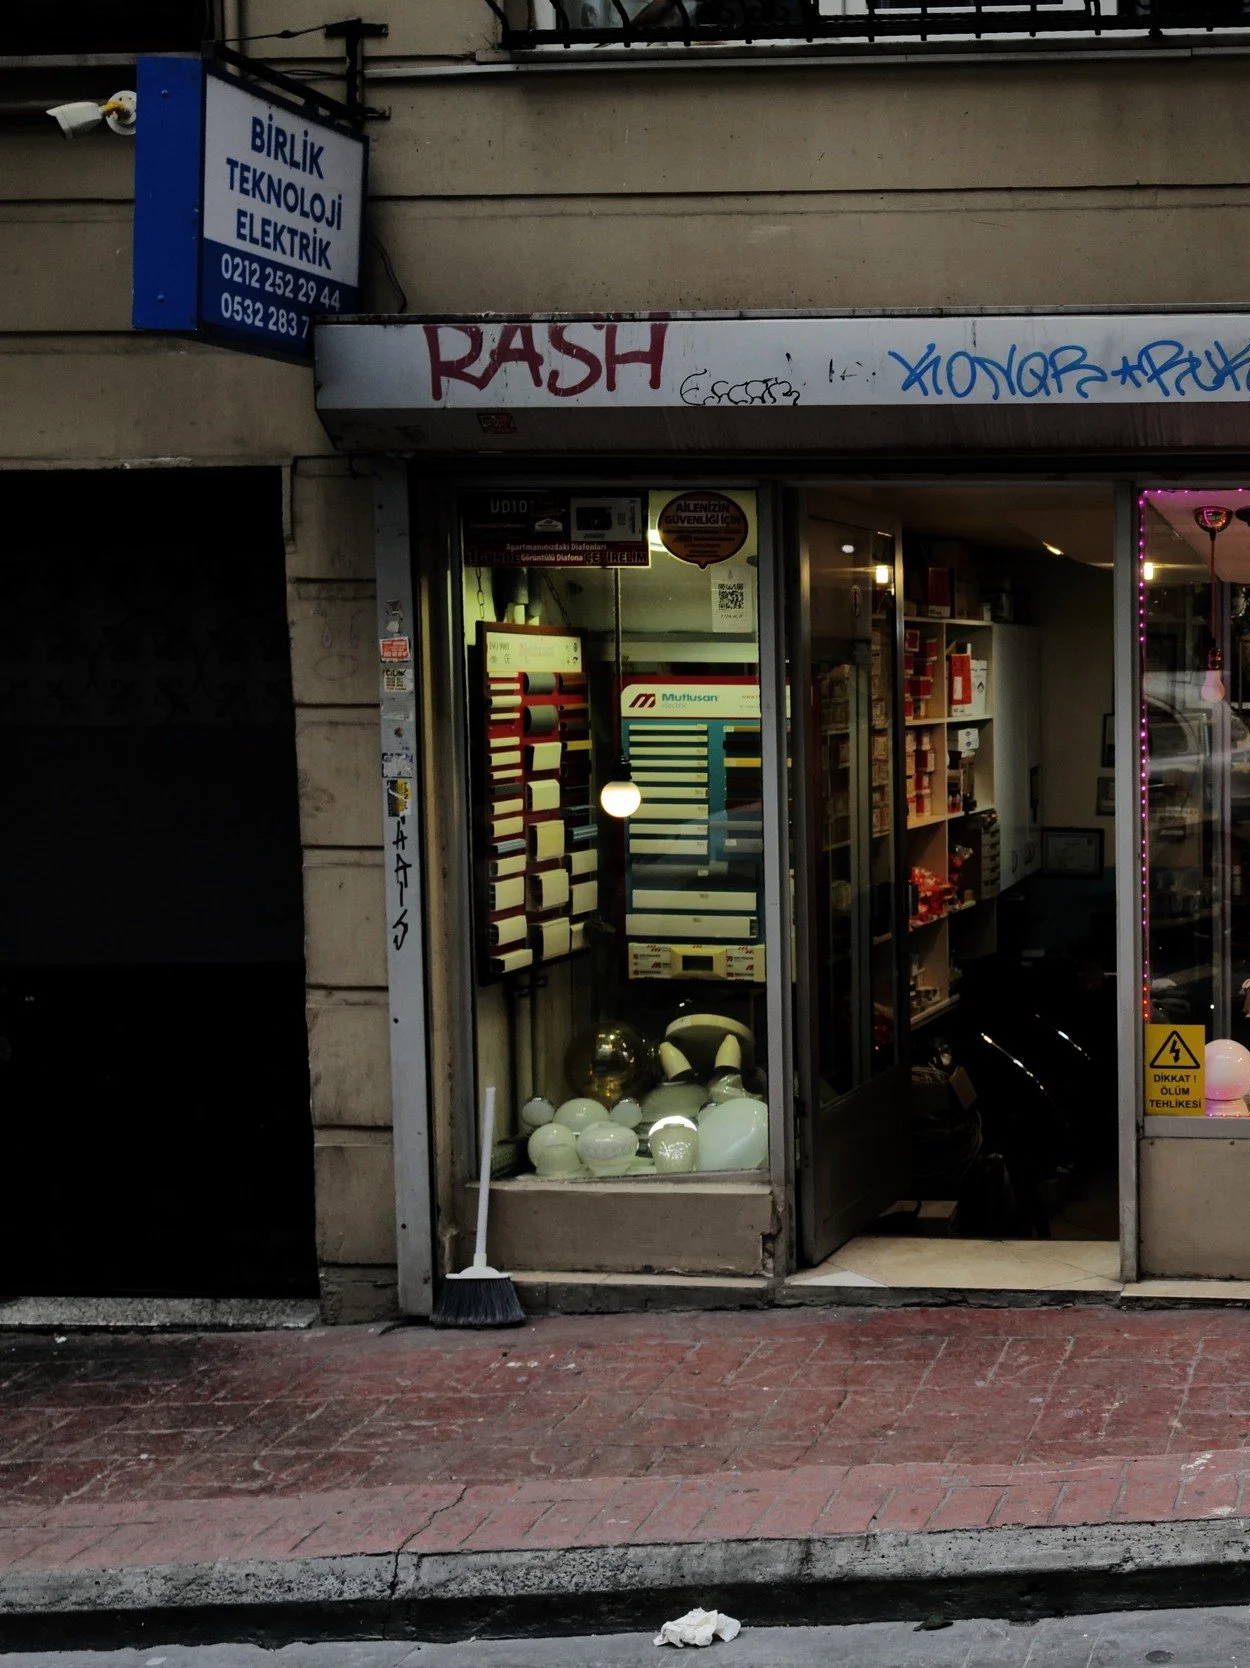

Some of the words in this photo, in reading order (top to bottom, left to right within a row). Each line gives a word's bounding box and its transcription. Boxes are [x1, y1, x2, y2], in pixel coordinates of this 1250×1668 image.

[251, 113, 324, 180] BİRLİK
[226, 156, 342, 231] TEKNOLOJİ
[236, 208, 332, 271] ELEKTRİK
[221, 253, 261, 288] 0212
[264, 266, 294, 298] 252
[298, 277, 316, 304] 29
[320, 288, 340, 312] 44
[221, 292, 264, 328] 0532
[268, 305, 297, 337] 283
[422, 311, 677, 401] RASH
[675, 500, 730, 513] AİLENİZİN
[665, 513, 720, 525] GÜVENLİĞİ
[721, 513, 741, 526] İÇİN
[556, 553, 583, 562] Diafona
[584, 549, 647, 565] ÇEVİRELİM
[661, 693, 718, 702] Mutlusan
[1153, 1073, 1191, 1083] DİKKAT
[1160, 1086, 1190, 1096] ÖLÜM
[1150, 1099, 1201, 1109] TEHLİKESİ
